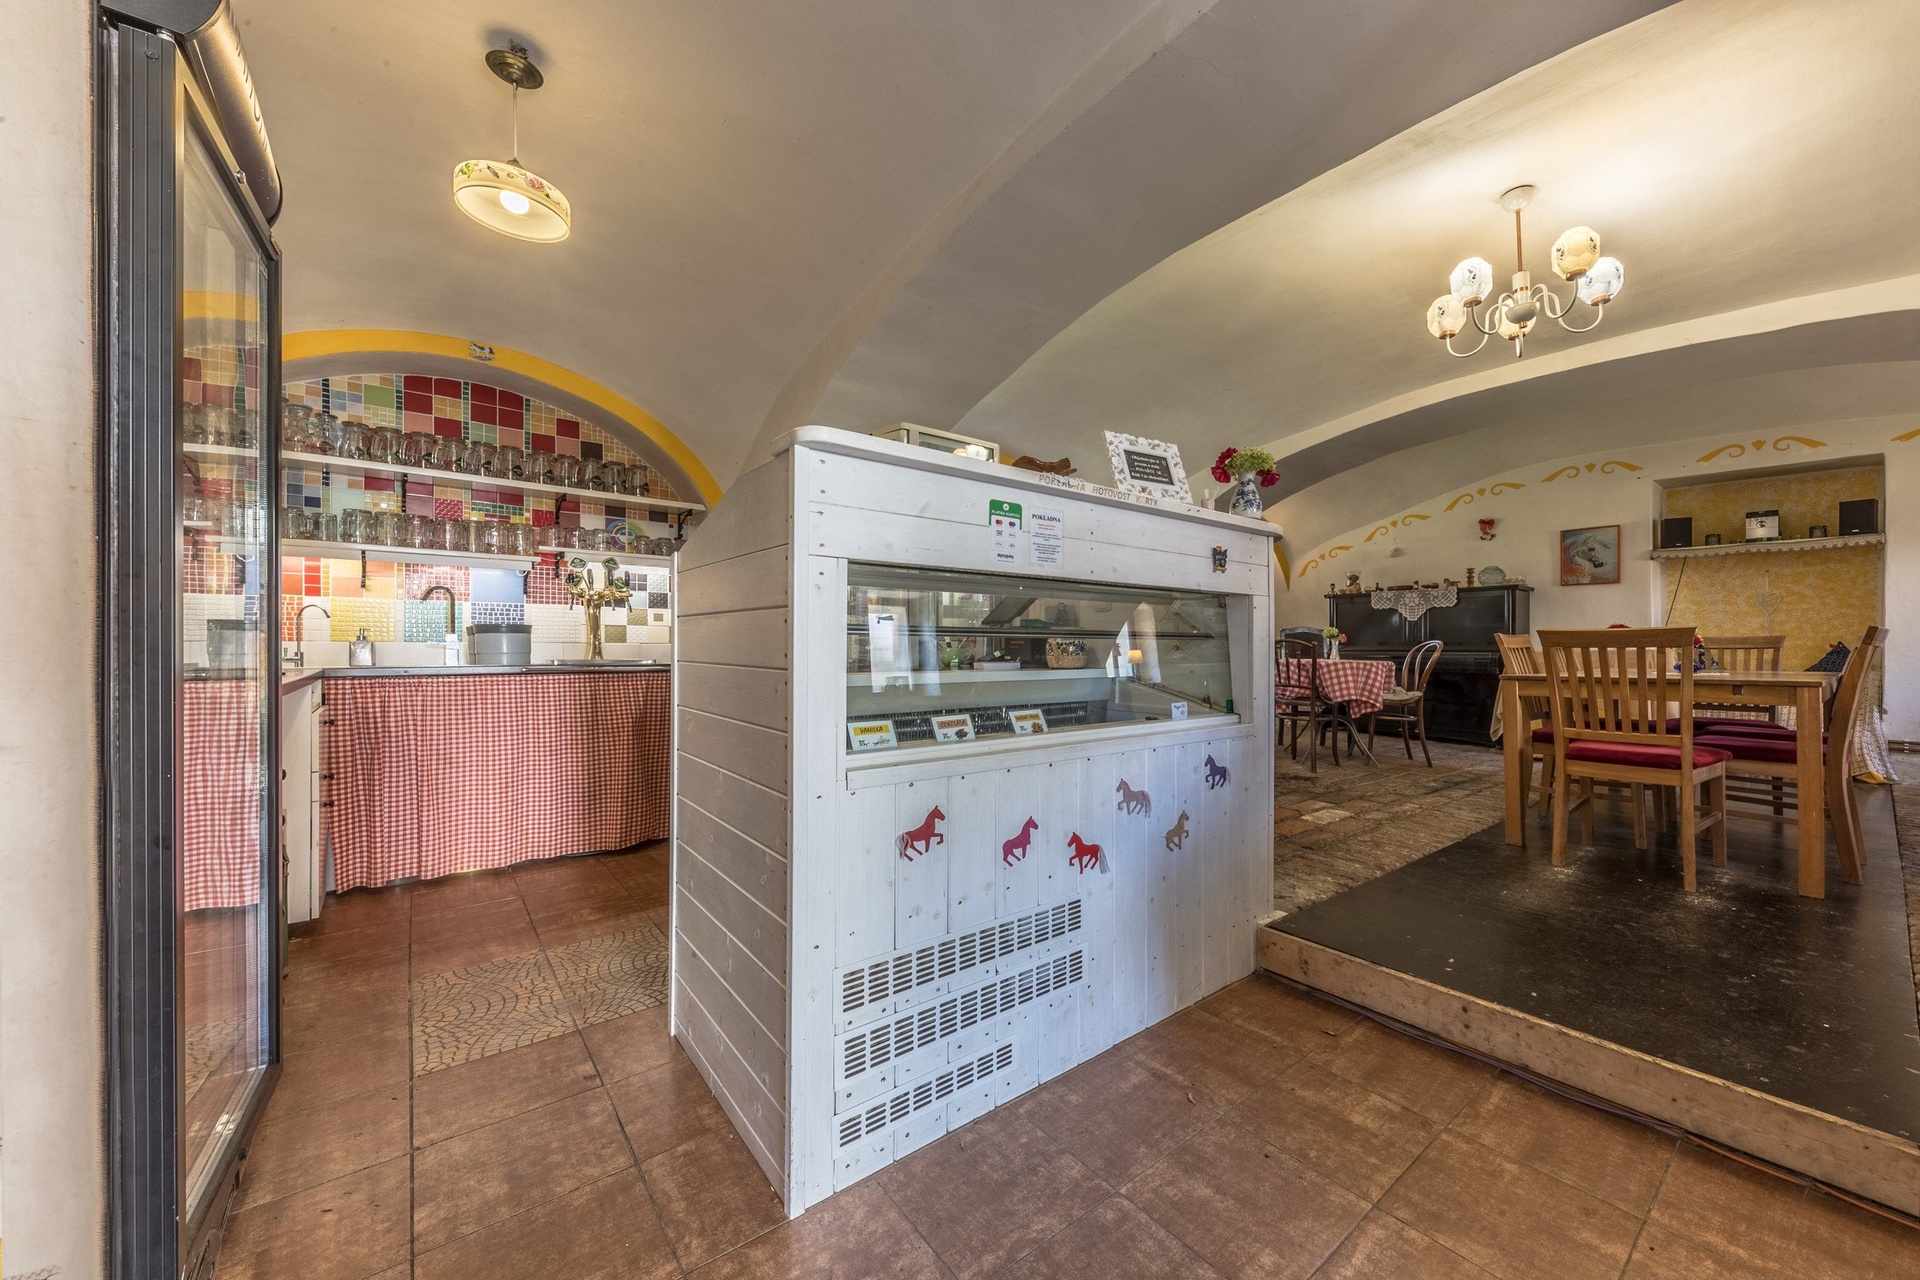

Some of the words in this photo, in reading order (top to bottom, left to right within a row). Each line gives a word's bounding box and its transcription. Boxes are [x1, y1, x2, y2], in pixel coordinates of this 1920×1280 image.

[1092, 485, 1131, 500] HOTOVOST
[1031, 513, 1061, 523] POKLADNA
[859, 726, 884, 734] VANILKA
